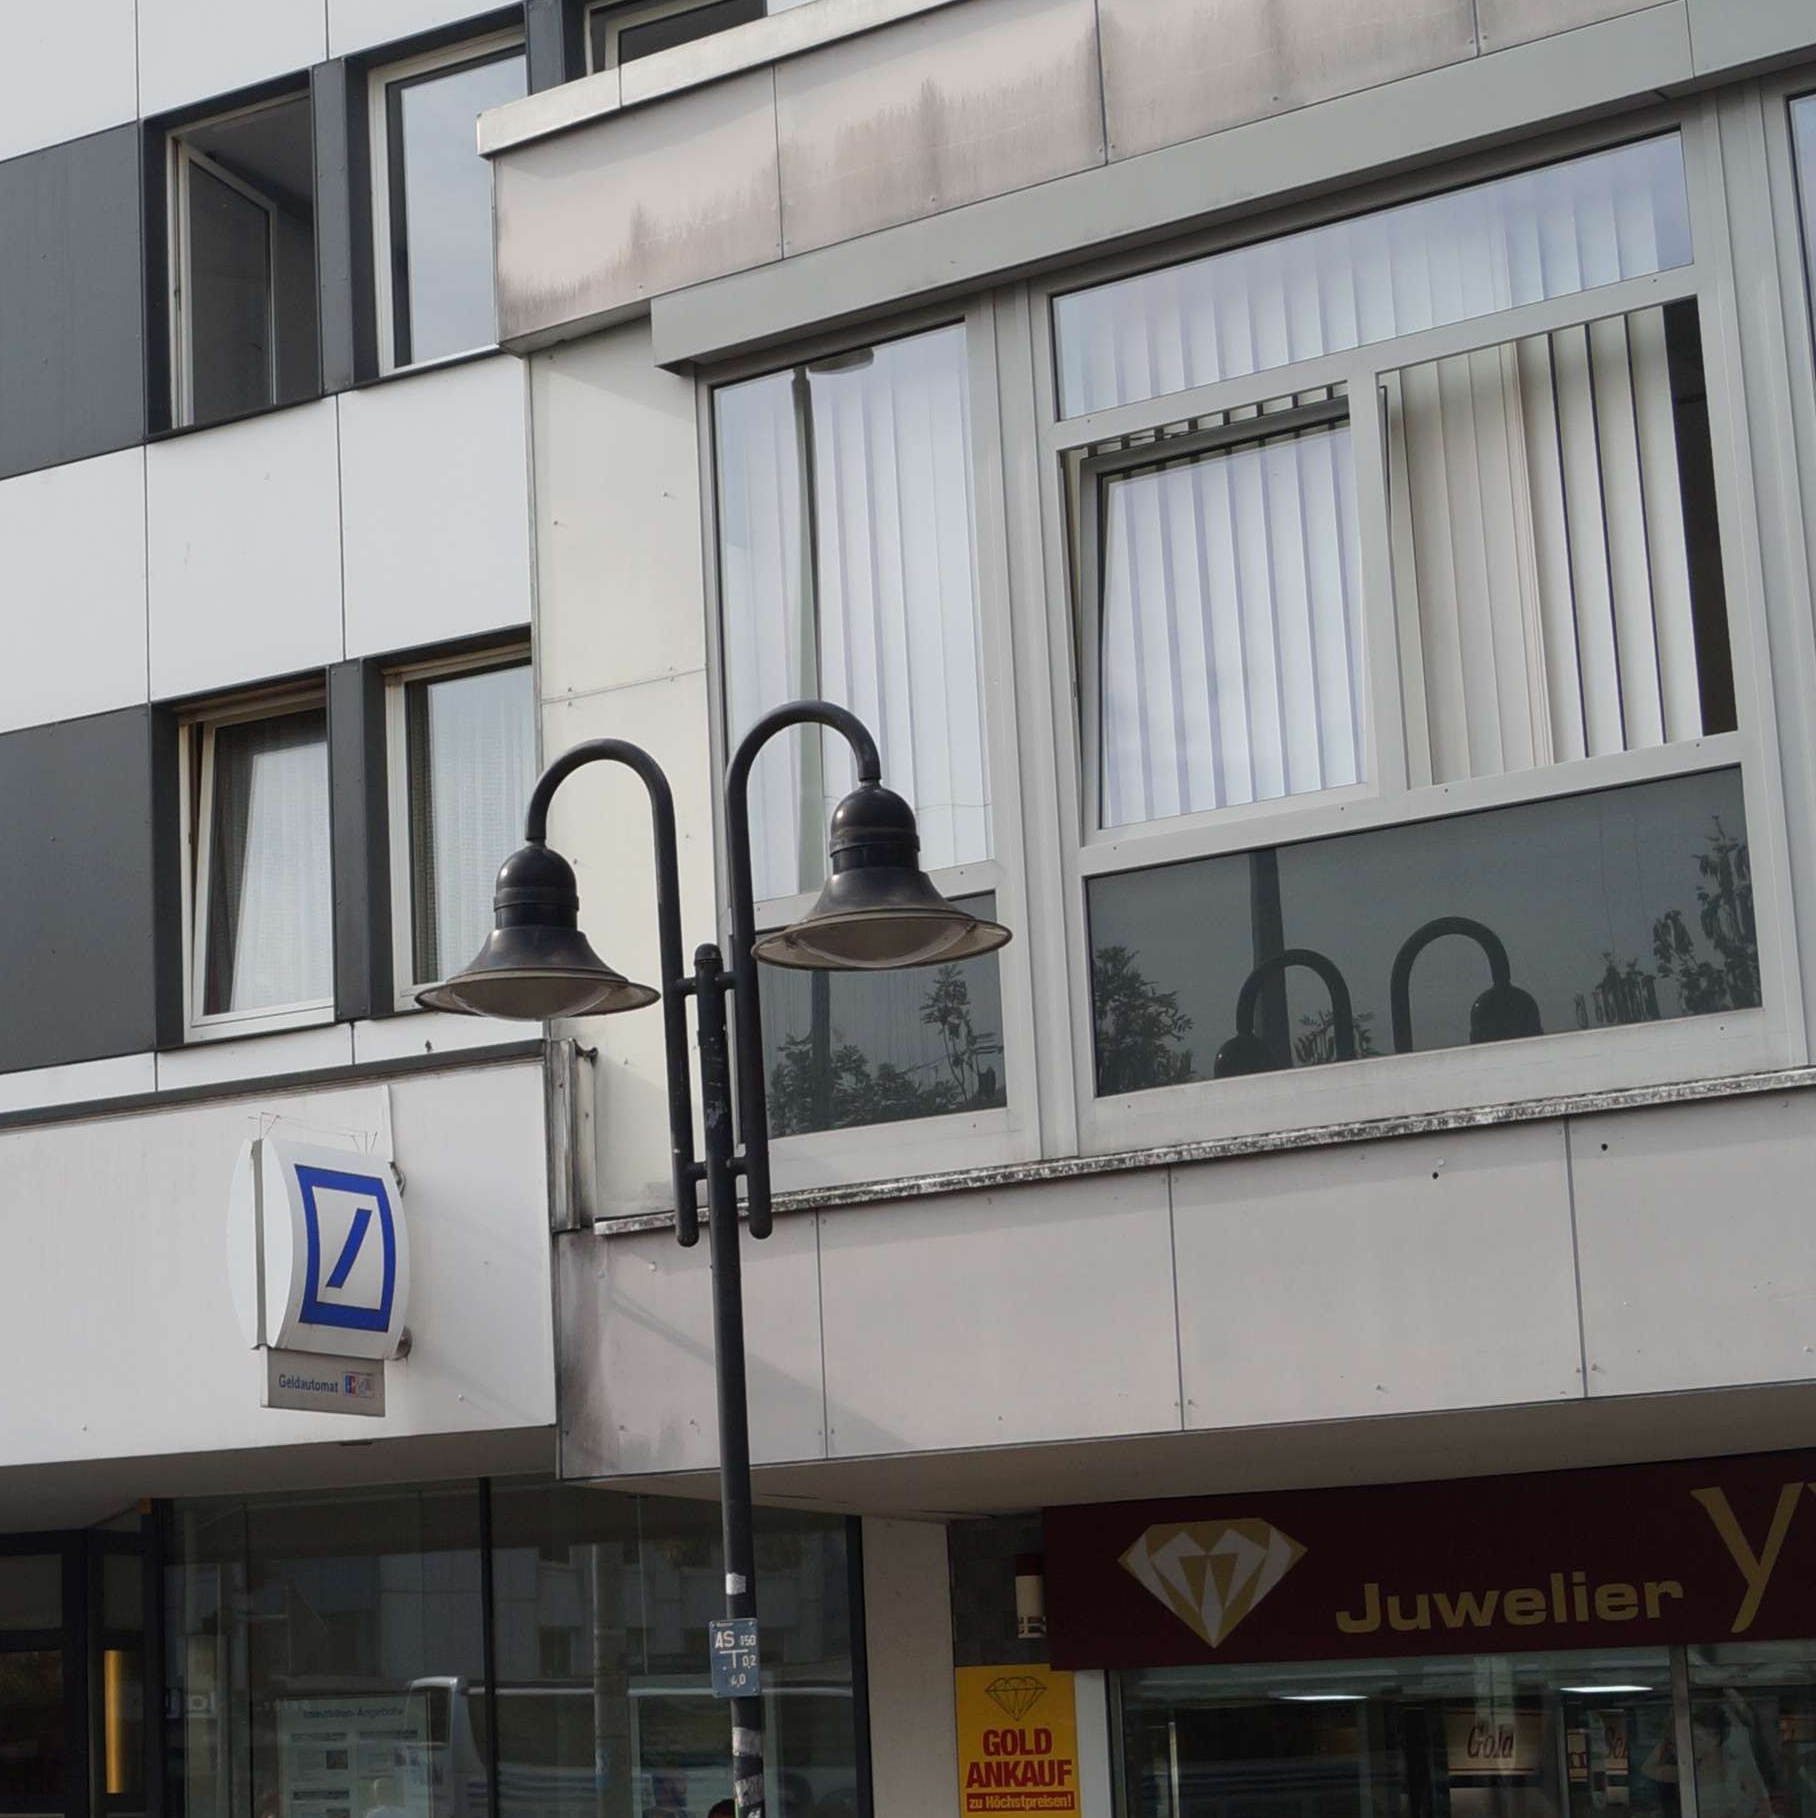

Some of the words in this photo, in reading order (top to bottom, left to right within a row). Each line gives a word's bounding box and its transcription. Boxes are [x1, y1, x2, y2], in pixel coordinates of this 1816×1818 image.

[278, 1374, 338, 1393] Geldautomat
[1335, 1571, 1685, 1634] Juwelier
[714, 1630, 735, 1649] AS
[983, 1728, 1053, 1757] GOLD
[966, 1759, 1073, 1788] ANKAUF
[969, 1798, 982, 1809] zu
[985, 1794, 1072, 1810] Höchstpreisen!
